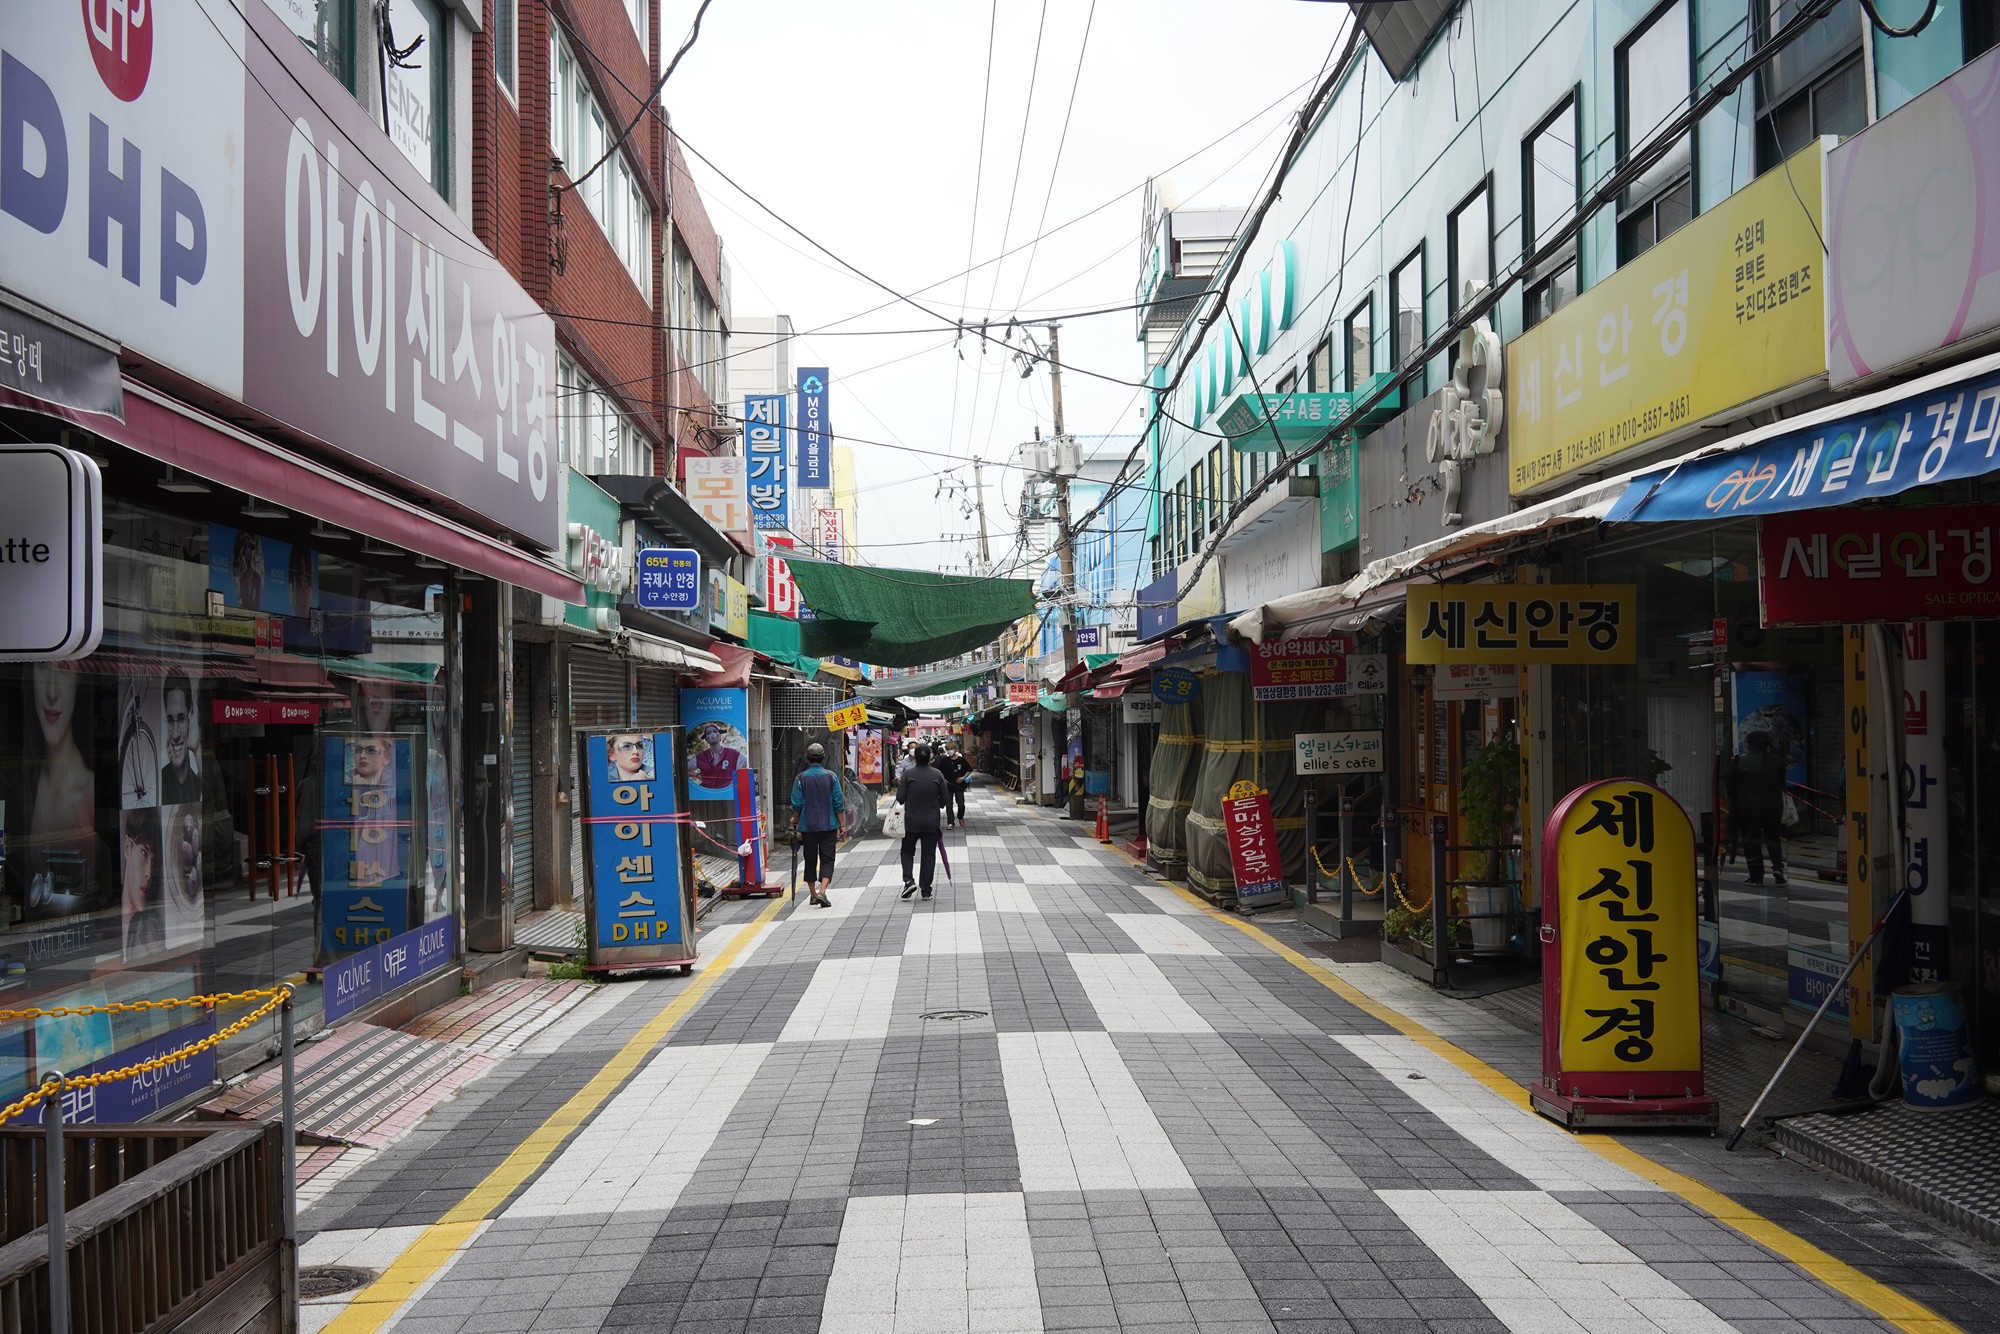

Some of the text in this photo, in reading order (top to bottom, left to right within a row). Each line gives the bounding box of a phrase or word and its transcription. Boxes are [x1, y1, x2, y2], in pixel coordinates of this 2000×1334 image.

[393, 119, 418, 158] ITALY
[1, 49, 208, 308] DHP
[1734, 219, 1766, 258] 수입테
[1735, 255, 1766, 293] 콘택트
[1735, 265, 1811, 325] 누진다초점렌즈
[1516, 267, 1690, 424] 세신안경
[748, 399, 785, 511] 제일가방
[645, 557, 669, 568] 65년
[1780, 526, 1993, 585] 세일안경
[642, 572, 695, 589] 국제사 안경
[1925, 592, 1955, 605] SALE
[1420, 599, 1621, 652] 세신안경
[696, 697, 733, 705] ACUVUE
[1303, 756, 1376, 770] ellie's cafe
[612, 784, 656, 918] 아이센스
[1241, 880, 1283, 896] 주차금지
[27, 924, 91, 962] NATURELLE
[418, 928, 445, 958] ACUVUE
[612, 920, 668, 941] DHP
[1575, 791, 1668, 1062] 세신안경
[337, 960, 372, 997] ACUVUE
[131, 1040, 191, 1094] ACUVUE
[131, 1071, 192, 1106] BRAND CONTACT LENSES
